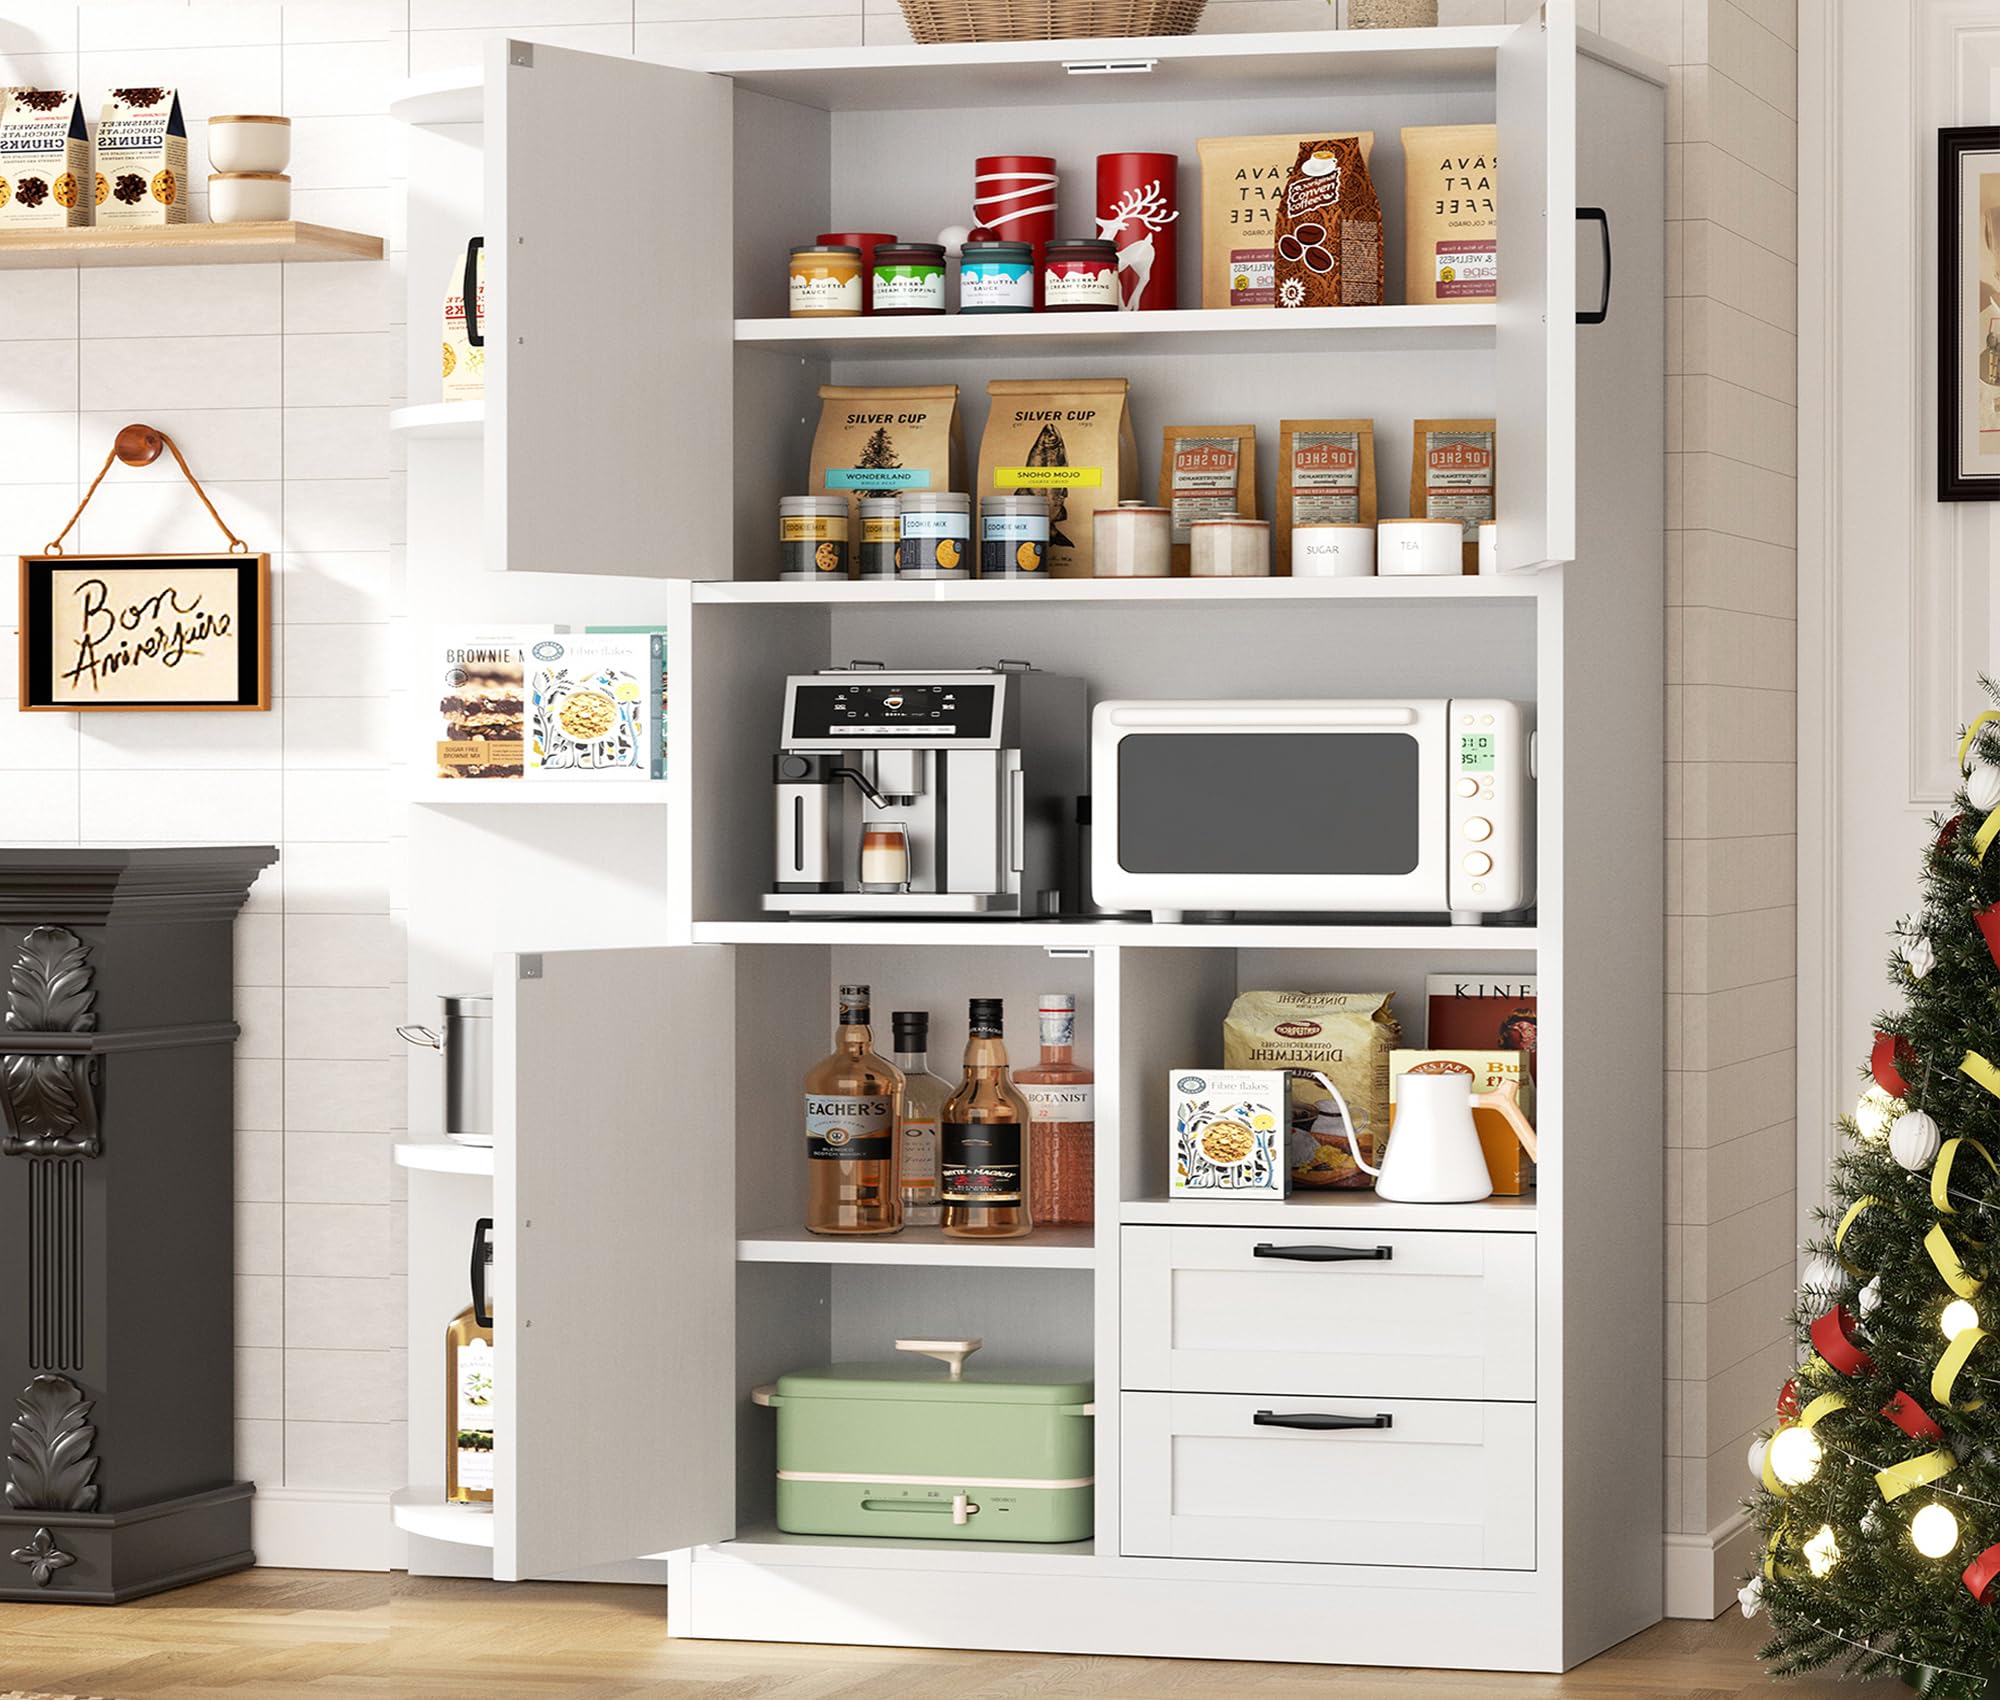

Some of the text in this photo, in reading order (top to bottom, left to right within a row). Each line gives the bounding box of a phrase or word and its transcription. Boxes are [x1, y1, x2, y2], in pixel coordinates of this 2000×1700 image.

[847, 414, 927, 424] SILVER CUP
[1015, 411, 1096, 421] SILVER CUP
[1306, 545, 1340, 555] SUGAR
[1400, 541, 1419, 550] TEA
[74, 579, 202, 647] Bon
[447, 649, 510, 663] BROWNIE
[1455, 984, 1531, 1000] KINF
[1211, 1081, 1269, 1091] Fibre flakes
[1029, 1092, 1088, 1102] BOTANIST
[808, 1101, 886, 1116] EACHER'S
